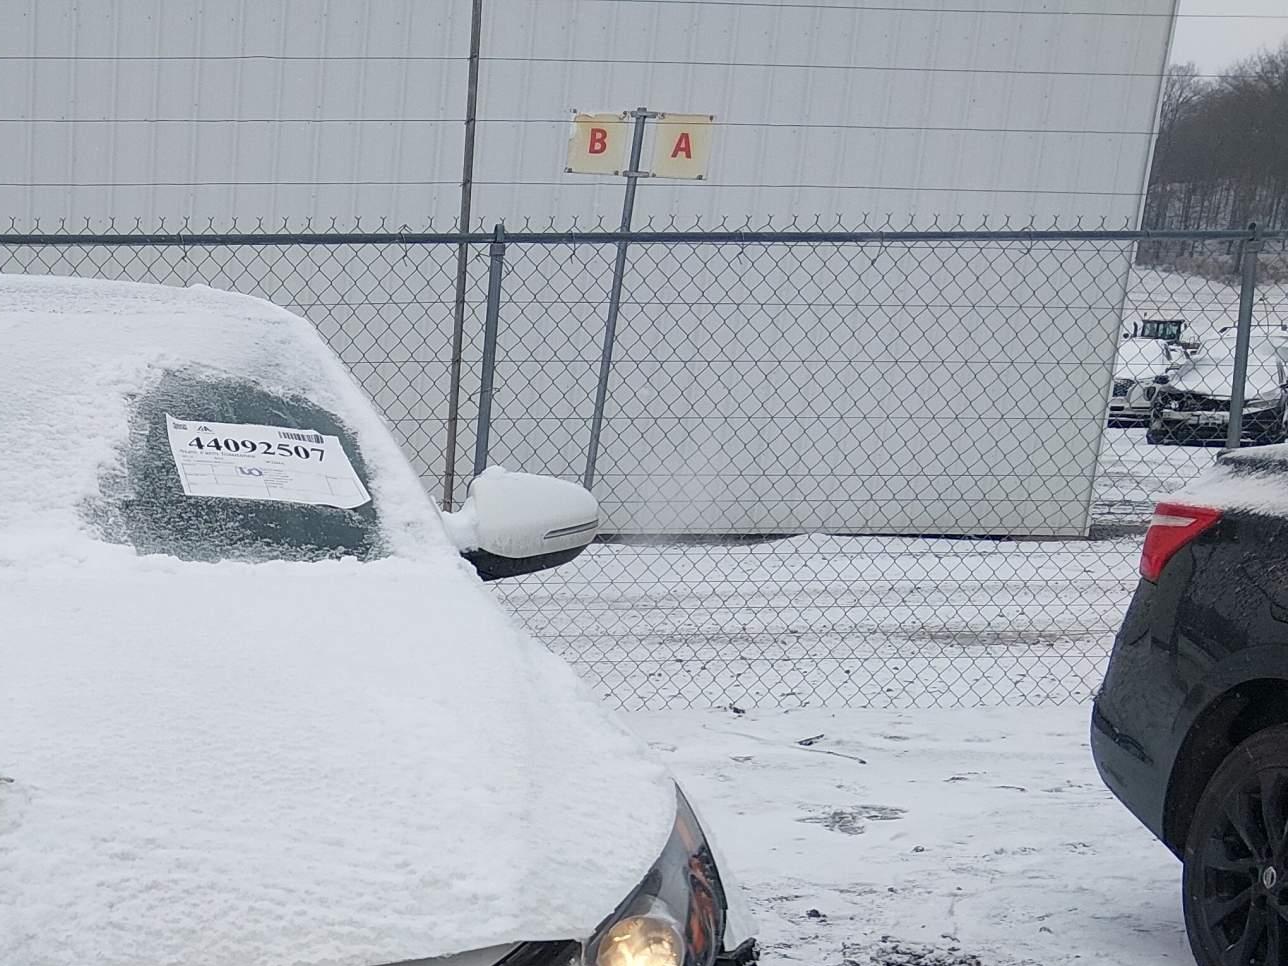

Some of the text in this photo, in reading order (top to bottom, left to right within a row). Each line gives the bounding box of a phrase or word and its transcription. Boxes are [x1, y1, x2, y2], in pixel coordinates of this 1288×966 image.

[588, 128, 608, 155] B
[671, 132, 692, 159] A
[188, 436, 325, 462] 44092507
